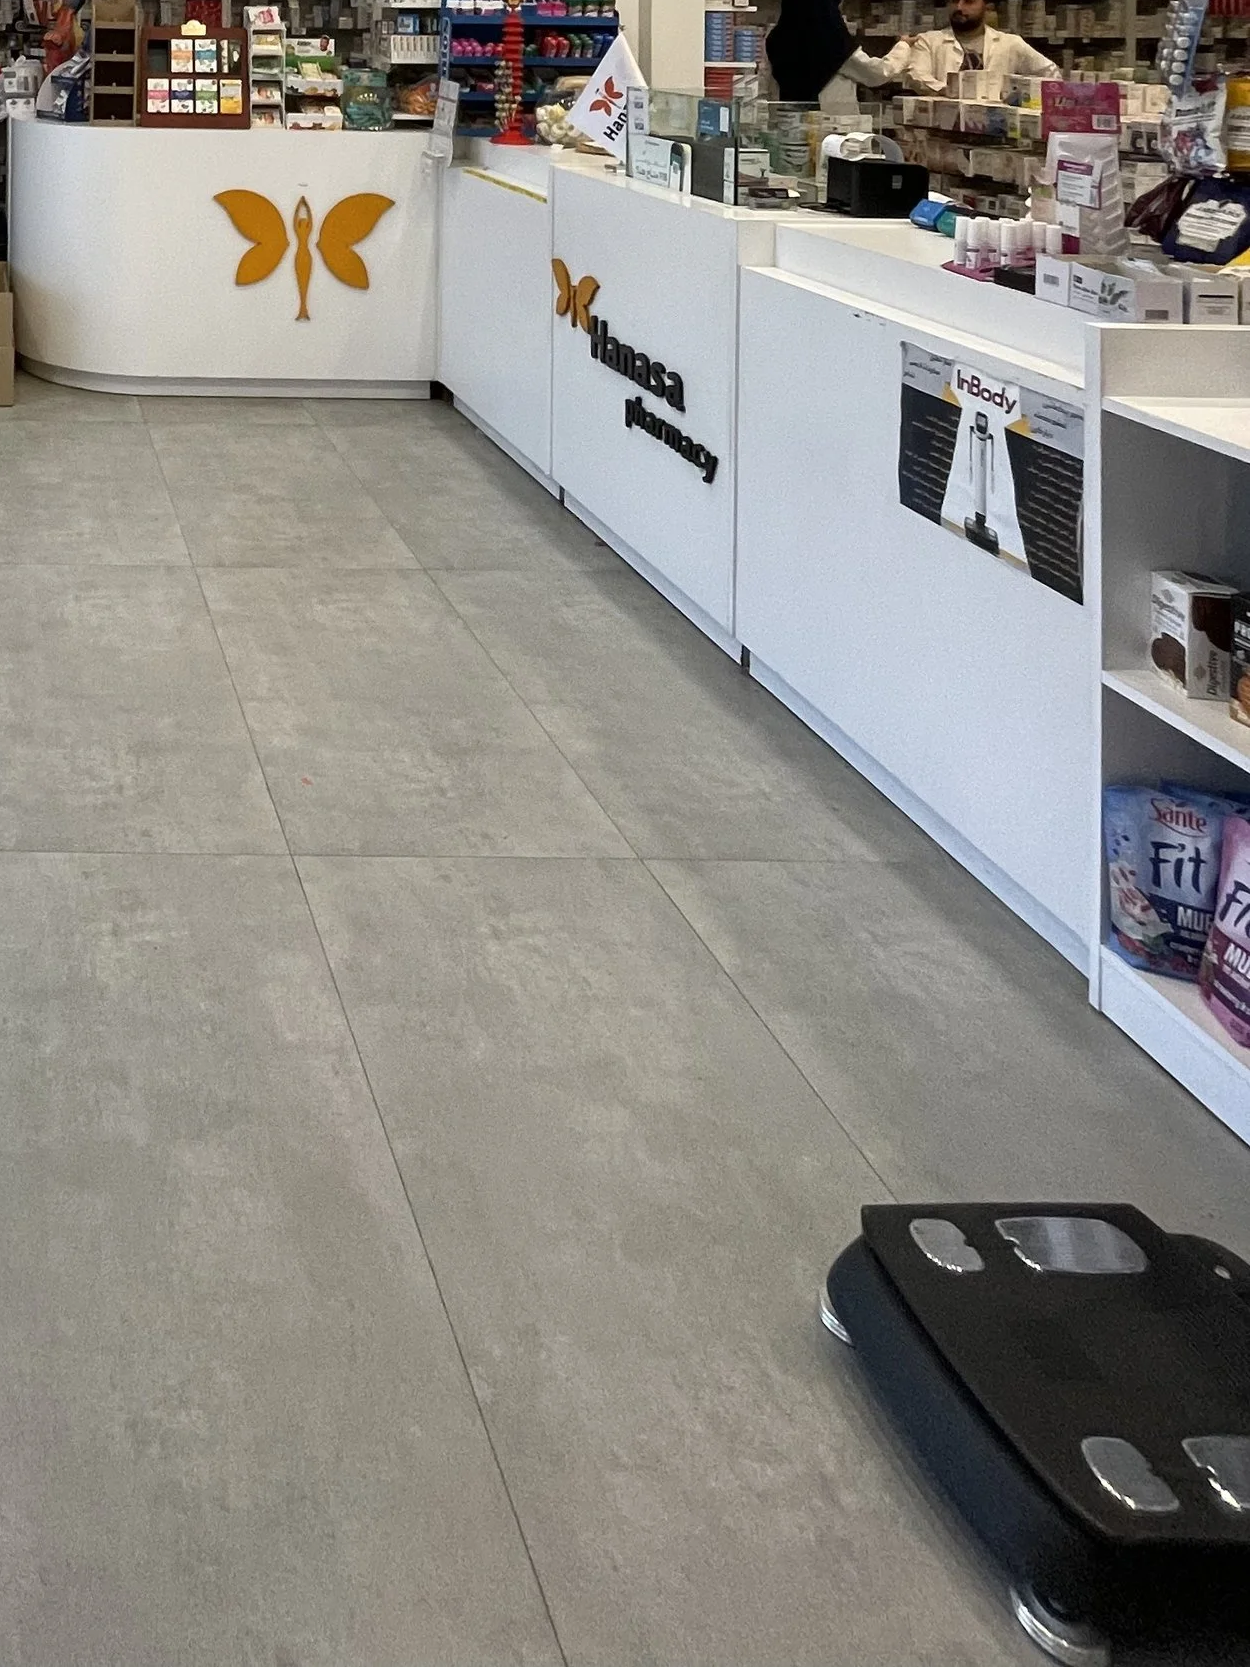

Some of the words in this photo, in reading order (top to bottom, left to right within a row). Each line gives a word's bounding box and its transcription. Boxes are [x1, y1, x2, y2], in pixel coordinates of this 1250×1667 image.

[590, 315, 686, 413] Hanasa
[956, 368, 1017, 415] InBody
[624, 396, 719, 484] pharmacy
[1149, 841, 1207, 895] Fit
